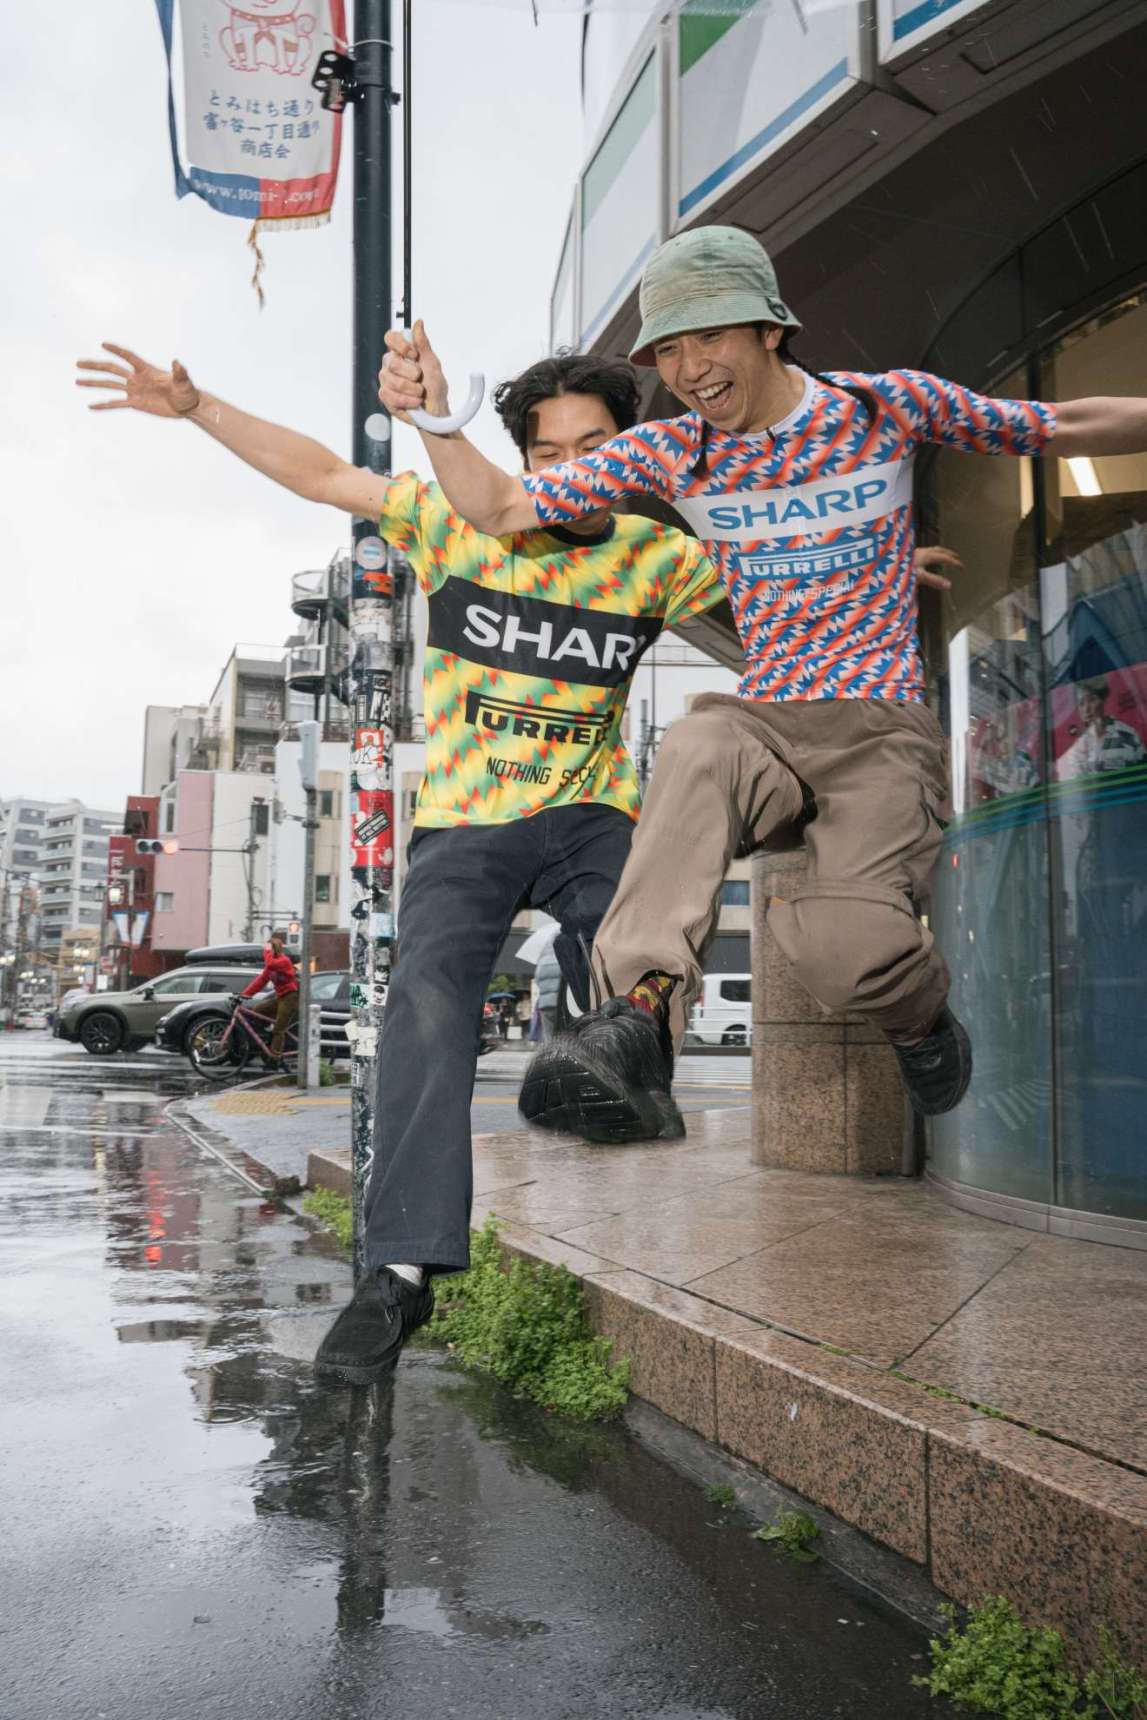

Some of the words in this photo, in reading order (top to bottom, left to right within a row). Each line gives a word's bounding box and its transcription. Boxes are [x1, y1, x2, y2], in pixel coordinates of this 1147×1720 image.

[209, 89, 314, 118] とみはち通り
[240, 138, 290, 159] 商店会
[707, 479, 888, 530] SHARP
[462, 604, 646, 672] SHAR
[486, 756, 552, 786] NOTHING
